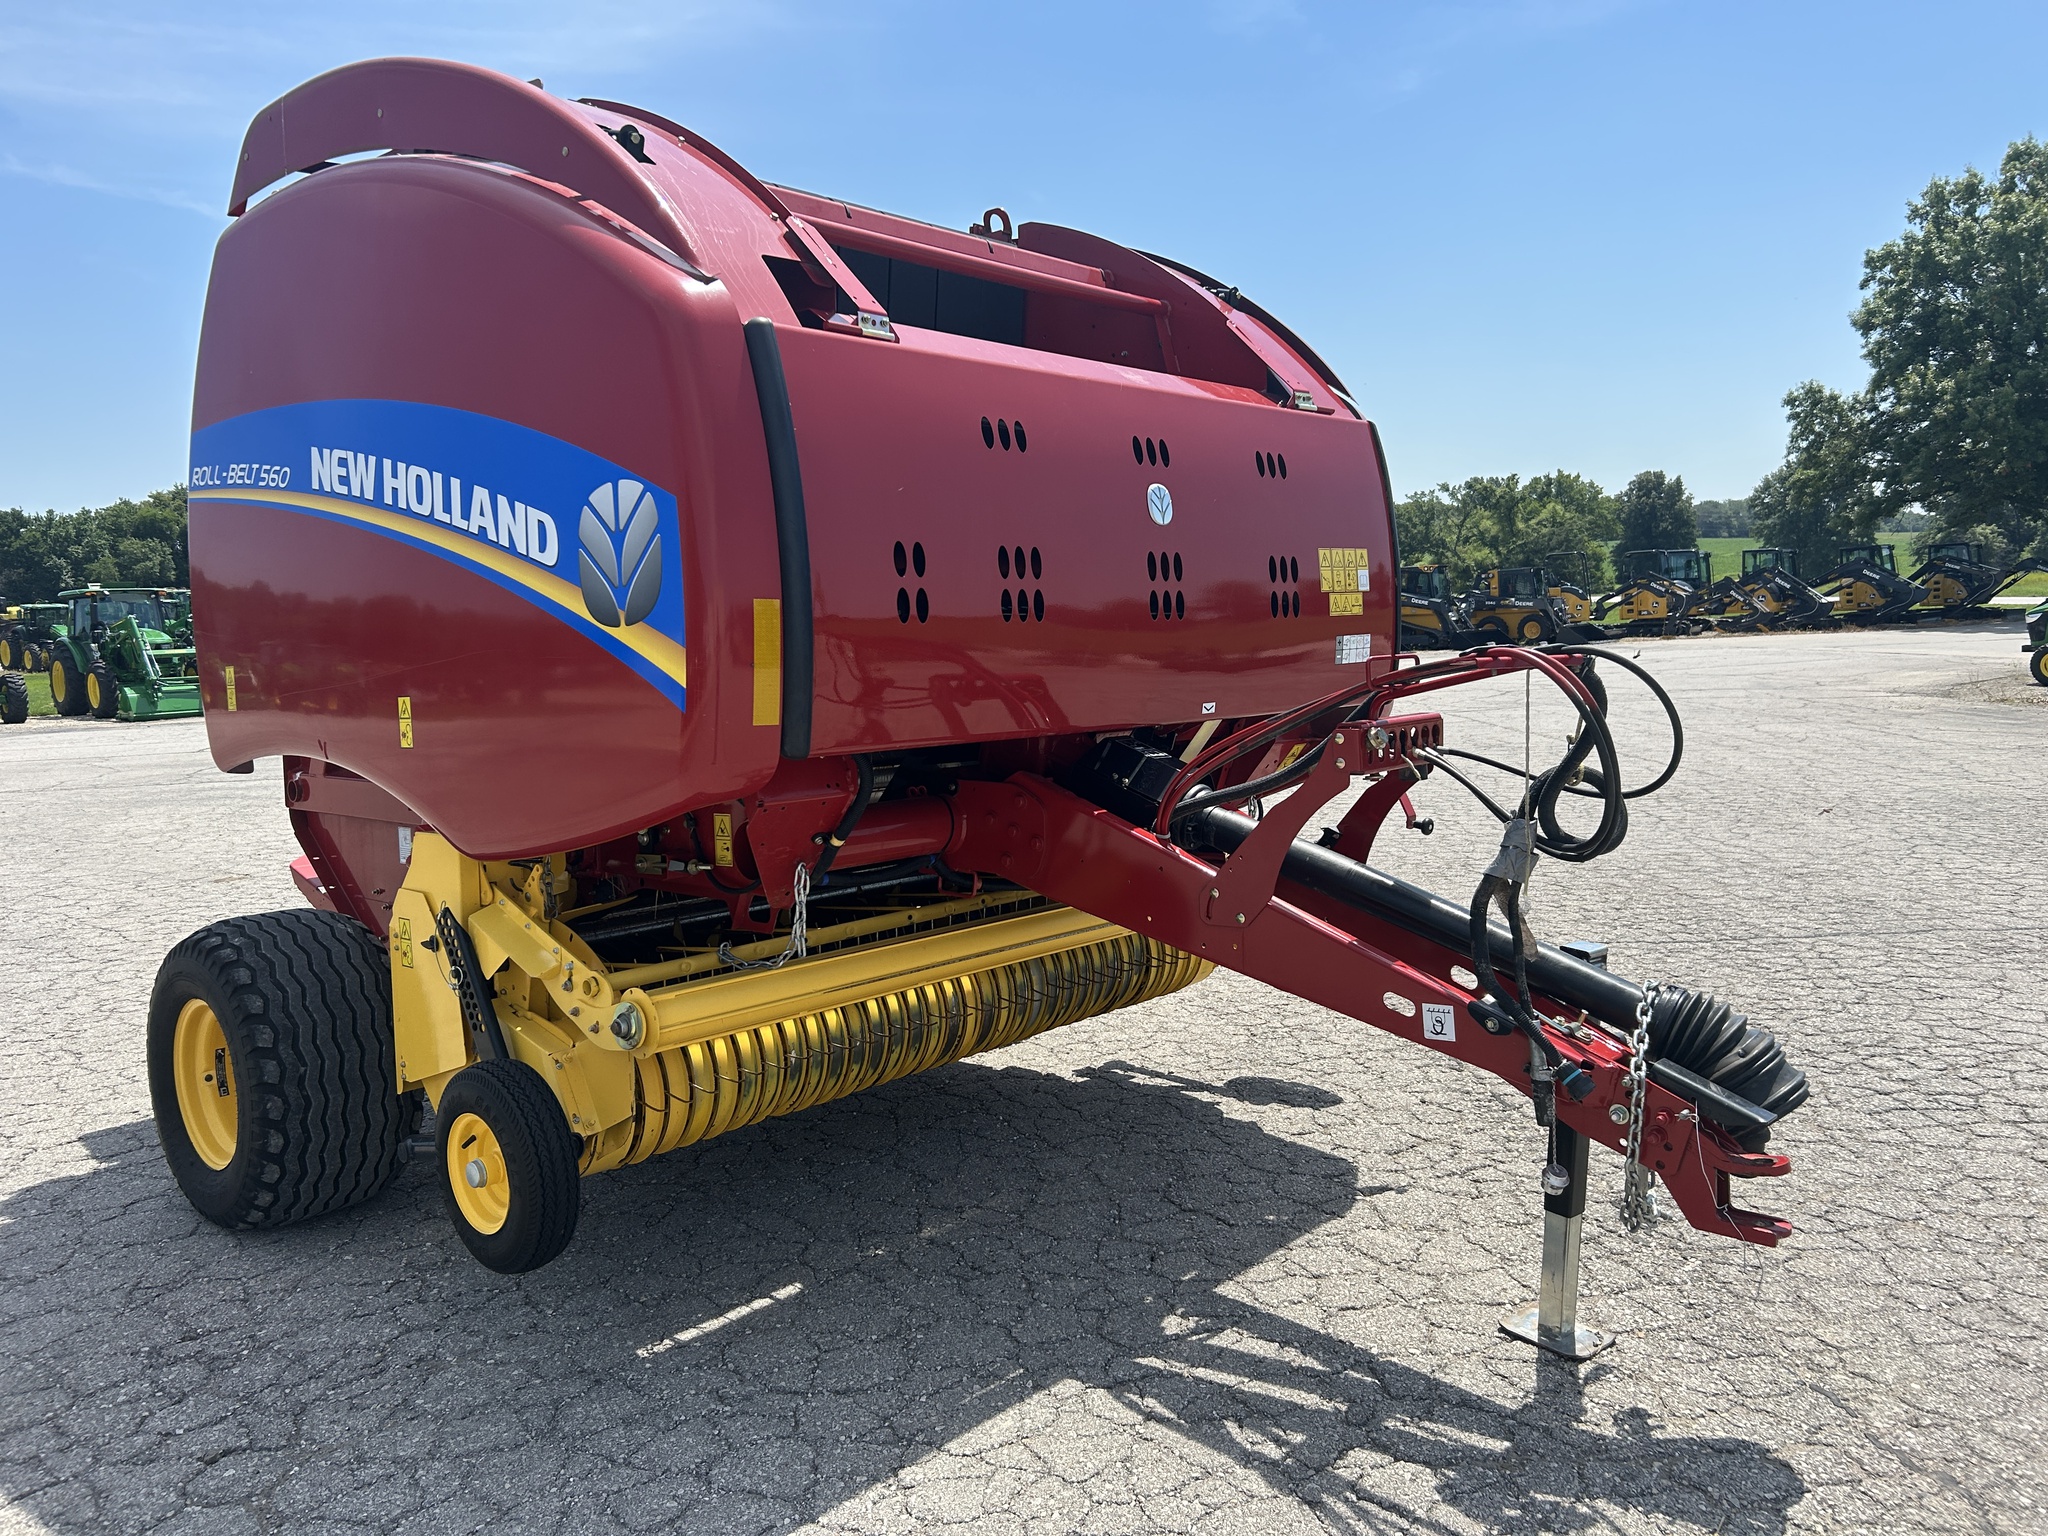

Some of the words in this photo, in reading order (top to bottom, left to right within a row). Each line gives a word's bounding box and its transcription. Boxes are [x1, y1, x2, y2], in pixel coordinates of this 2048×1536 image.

[191, 463, 260, 488] ROLL-BELT
[259, 464, 291, 488] 560
[310, 446, 377, 501] NEW
[382, 457, 559, 567] HOLLAND
[1862, 568, 1881, 580] DEERE
[1650, 581, 1667, 593] DEERE
[1774, 576, 1791, 589] DEERE
[1411, 597, 1429, 606] DEERE
[1729, 589, 1745, 602] DEERE
[1514, 598, 1534, 607] DEERE
